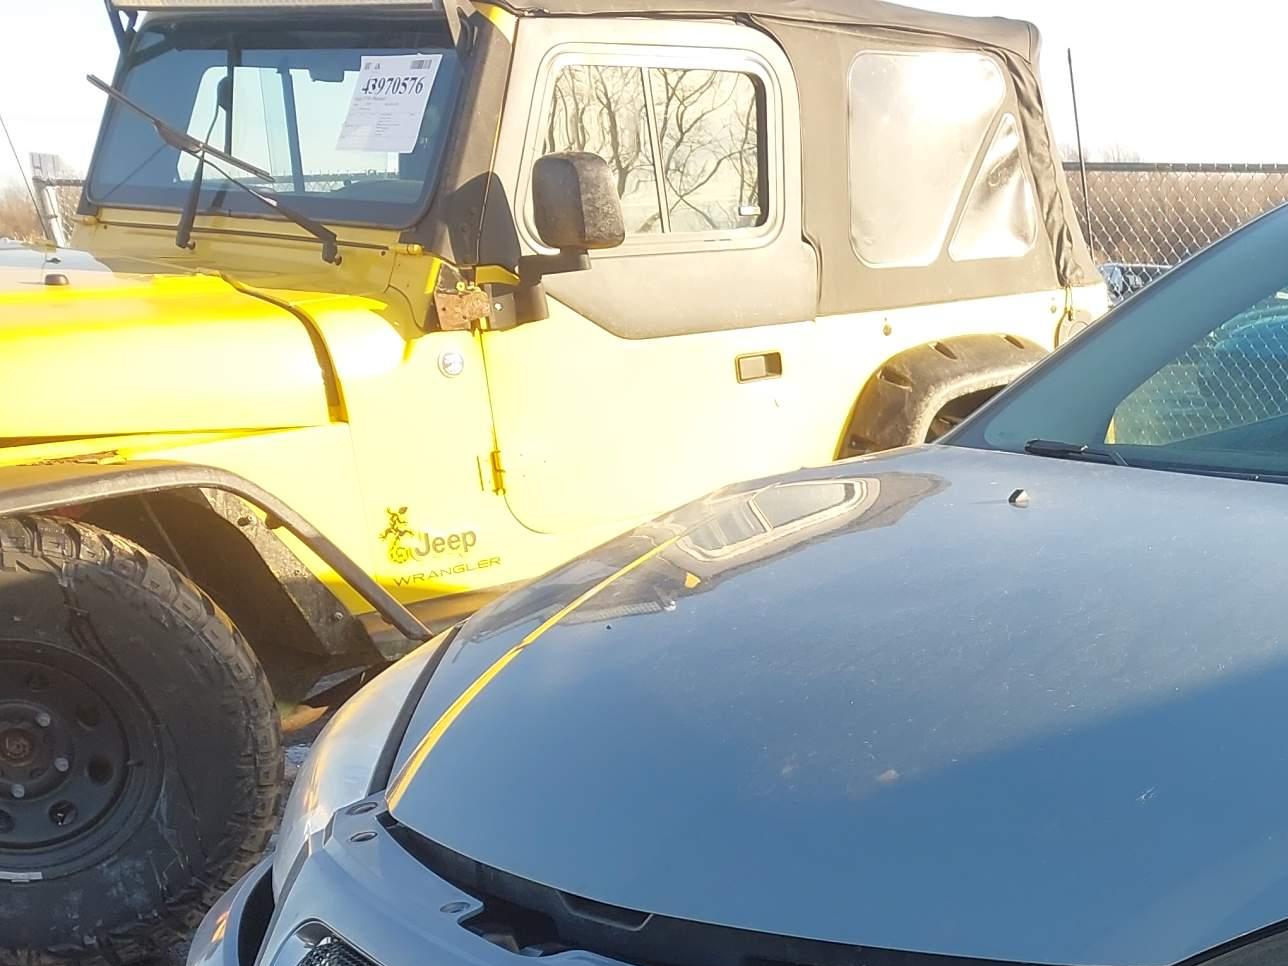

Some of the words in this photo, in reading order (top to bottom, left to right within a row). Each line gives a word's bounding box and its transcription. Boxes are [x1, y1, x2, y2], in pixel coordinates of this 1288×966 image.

[362, 76, 425, 95] 43970576
[414, 530, 477, 557] Jeep
[393, 556, 501, 587] WRANGLER
